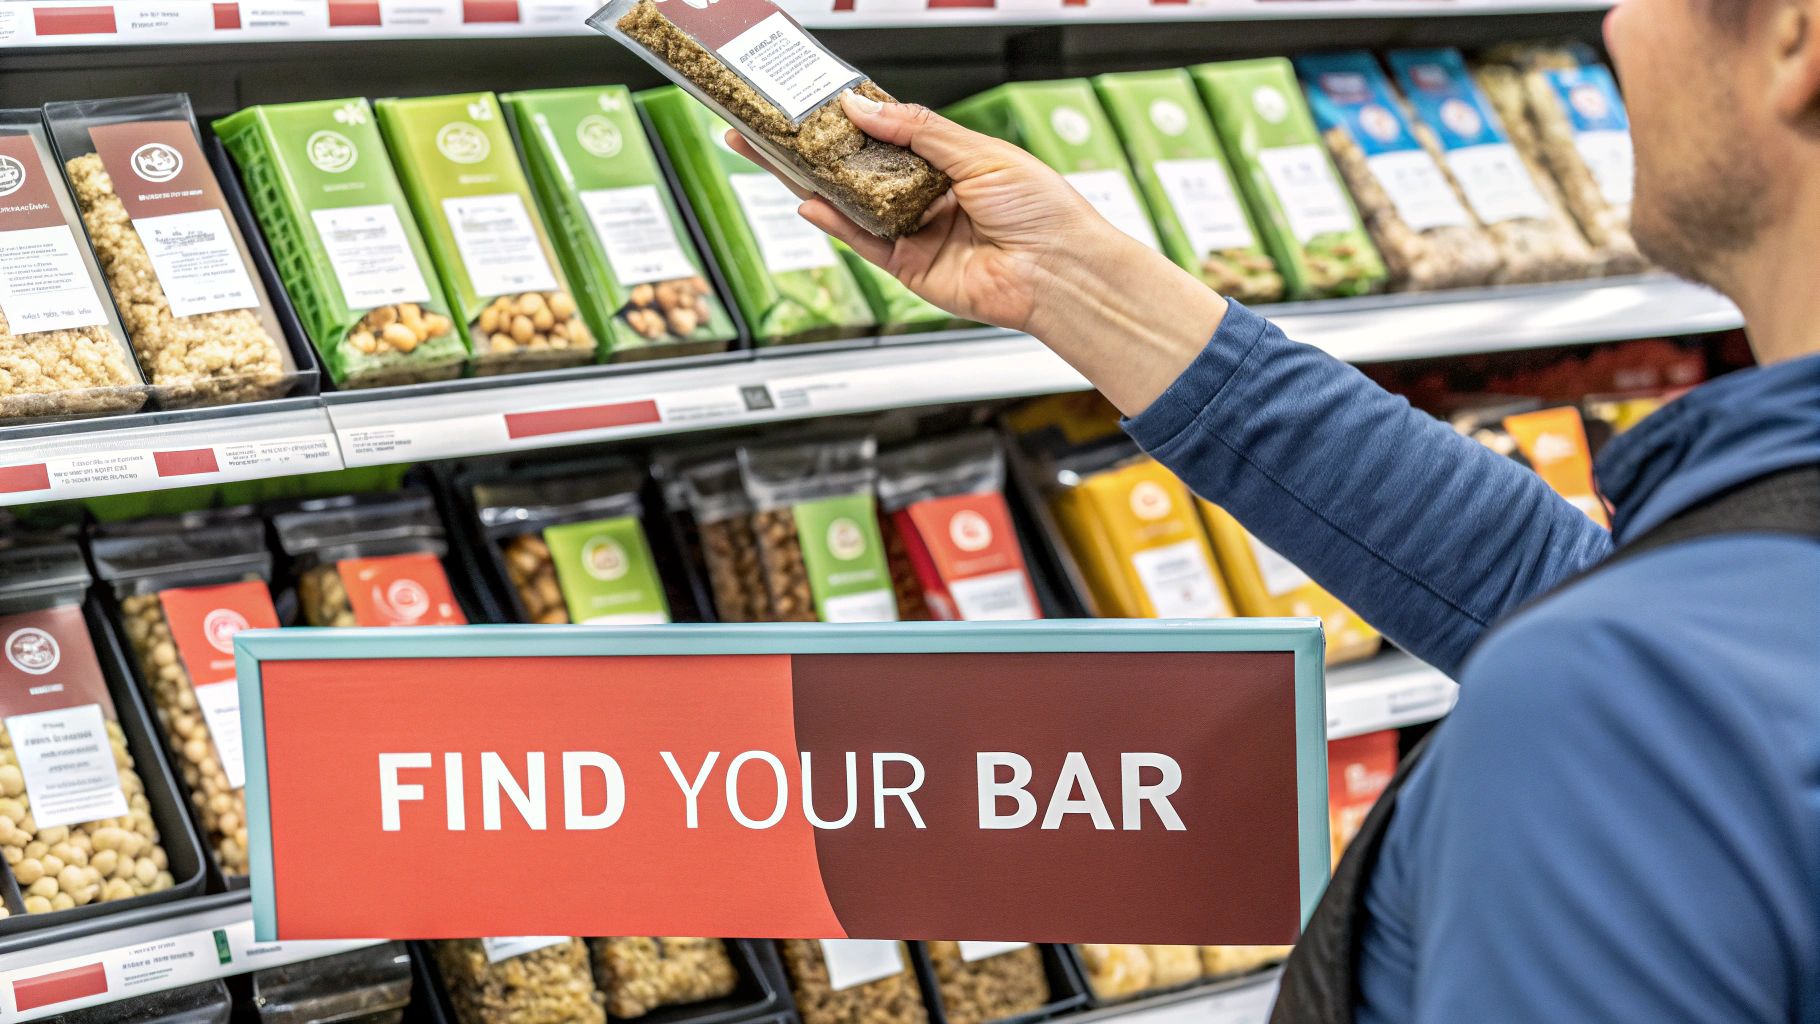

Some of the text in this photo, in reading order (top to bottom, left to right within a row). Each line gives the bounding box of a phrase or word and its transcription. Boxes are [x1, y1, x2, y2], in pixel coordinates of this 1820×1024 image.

[378, 749, 1187, 832] FIND YOUR BAR
